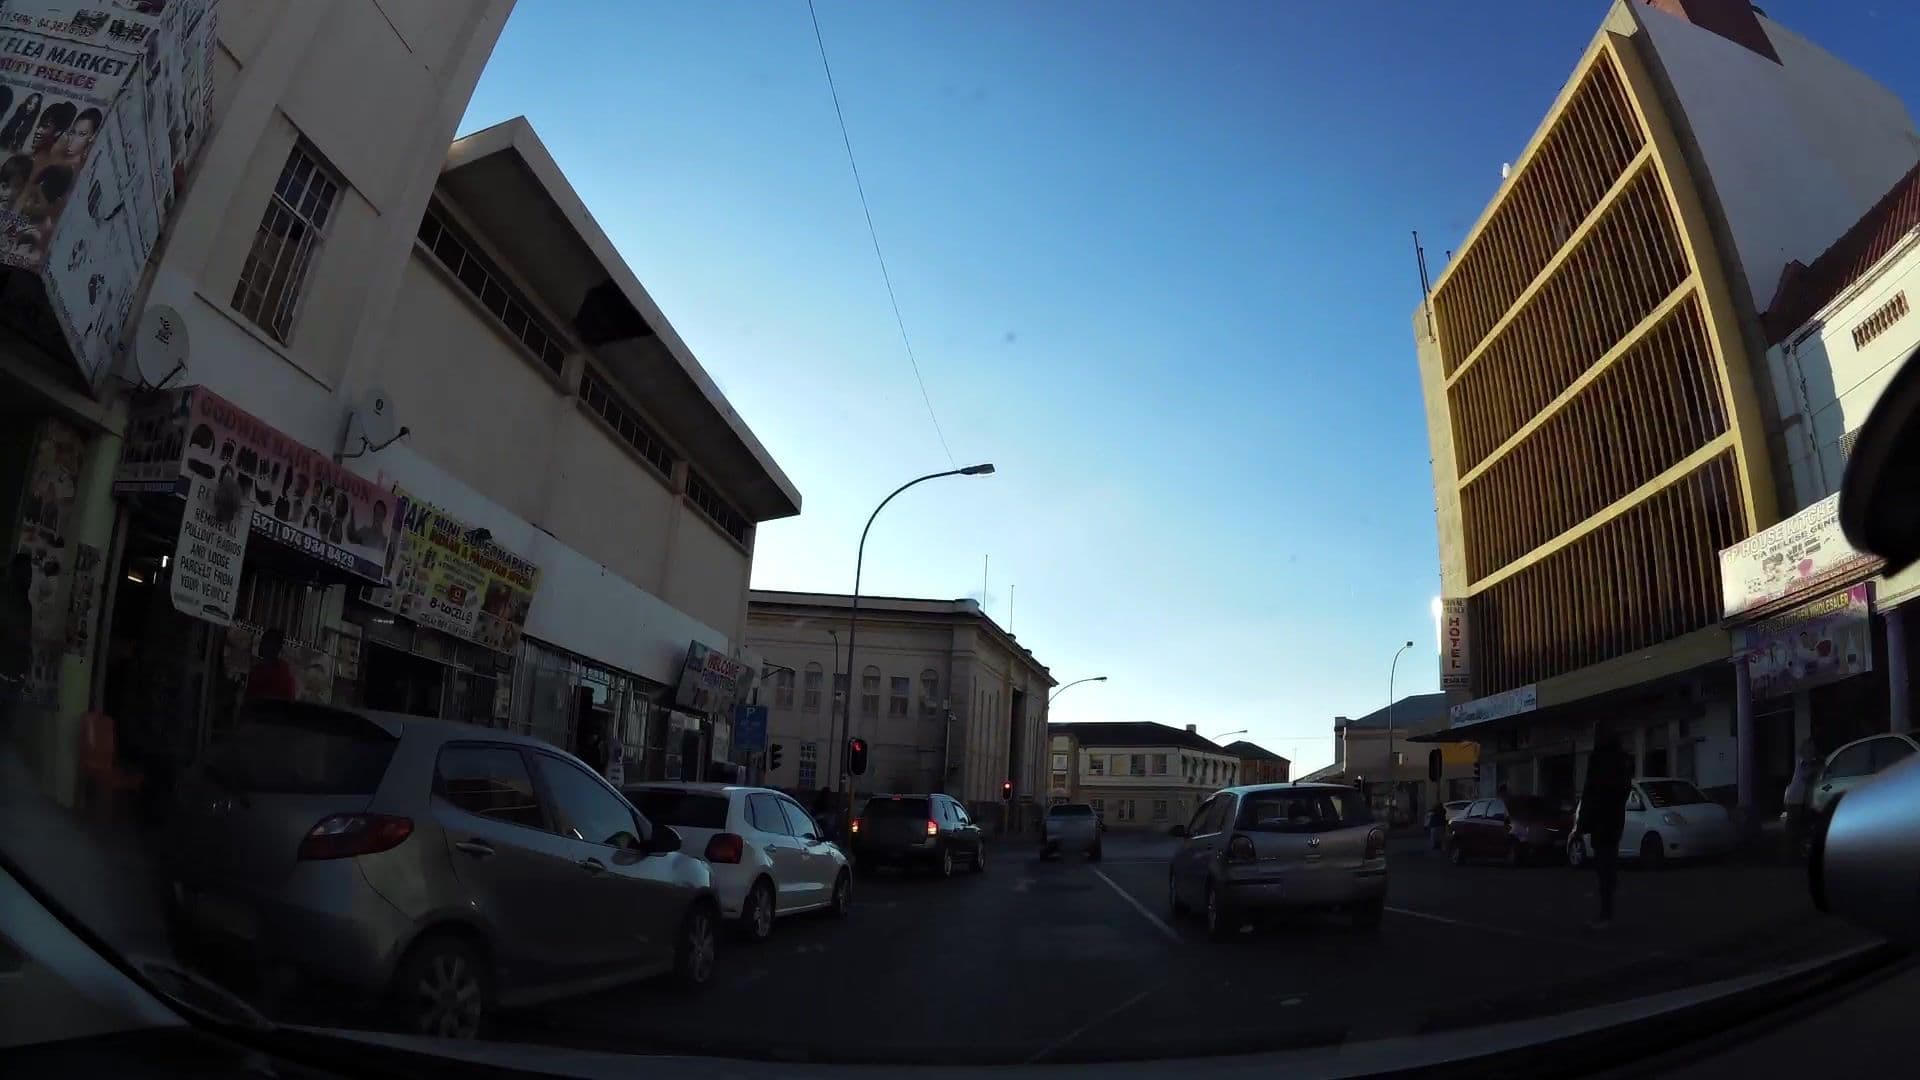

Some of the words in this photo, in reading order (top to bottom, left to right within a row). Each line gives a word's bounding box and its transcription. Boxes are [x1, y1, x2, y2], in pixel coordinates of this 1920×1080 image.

[4, 36, 46, 59] FLEA
[46, 45, 129, 76] MARKET
[1741, 525, 1784, 557] HOUSE
[1809, 592, 1849, 618] WHOLESALER
[1449, 617, 1460, 669] HOTEL
